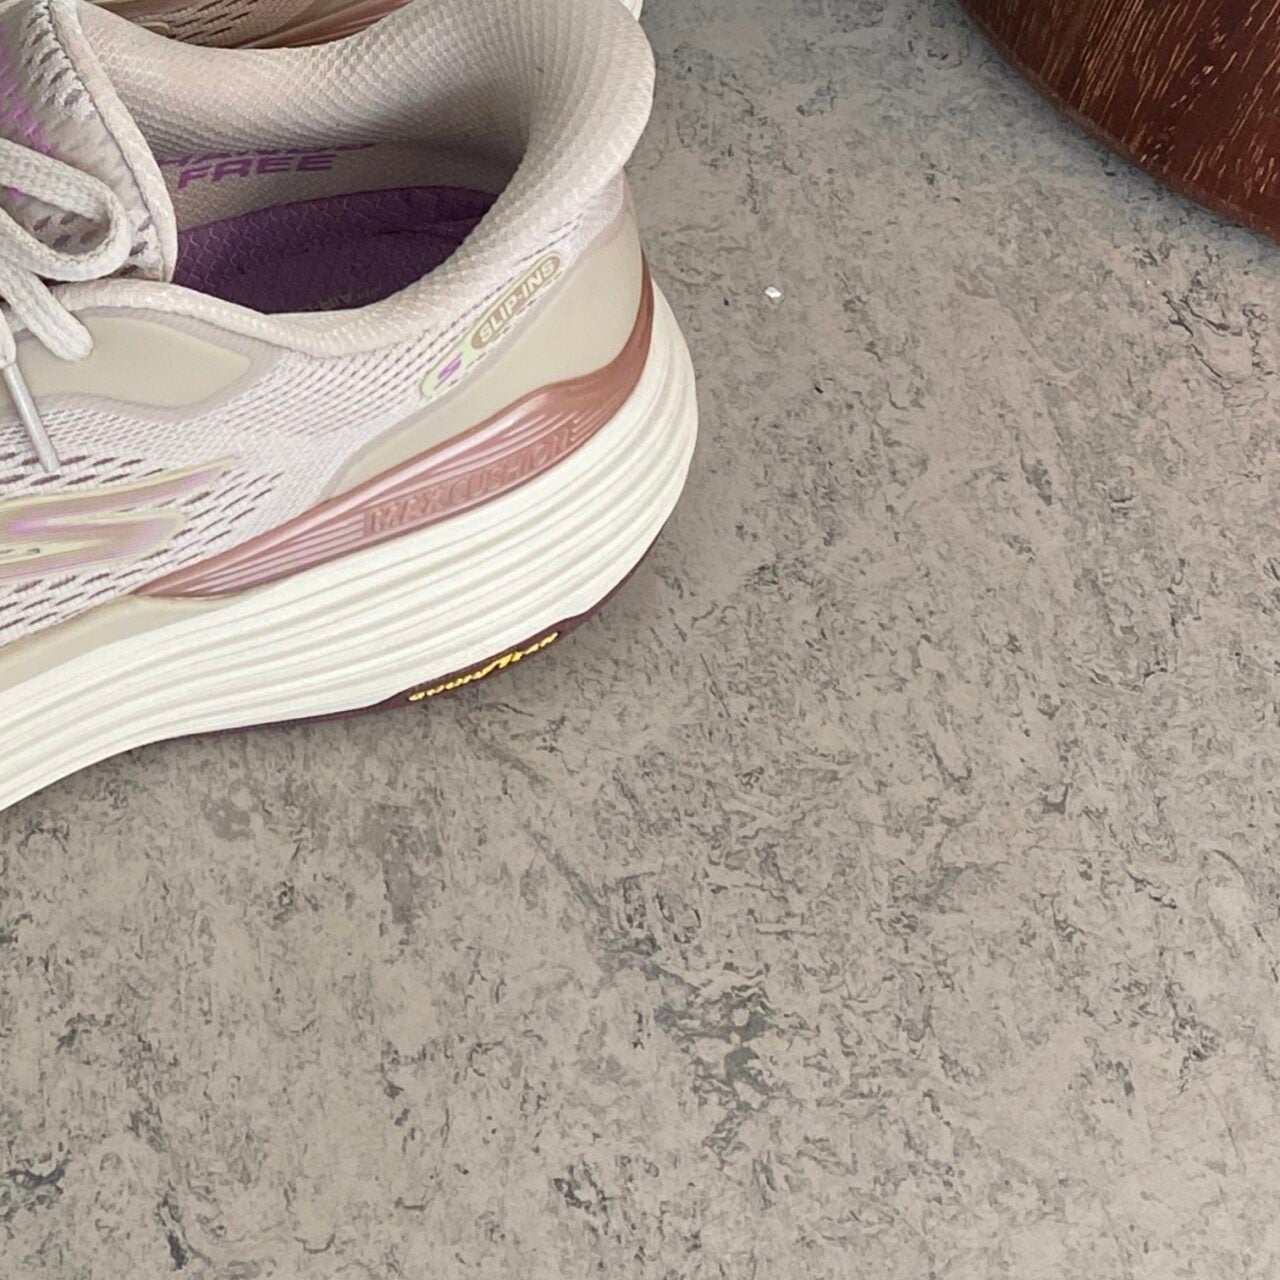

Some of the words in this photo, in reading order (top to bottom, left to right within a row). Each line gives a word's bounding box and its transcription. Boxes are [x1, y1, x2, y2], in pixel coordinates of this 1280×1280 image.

[177, 154, 337, 189] FREE
[478, 258, 556, 343] SLIP-INS
[370, 486, 443, 533] MAX
[448, 426, 570, 506] CUSHION
